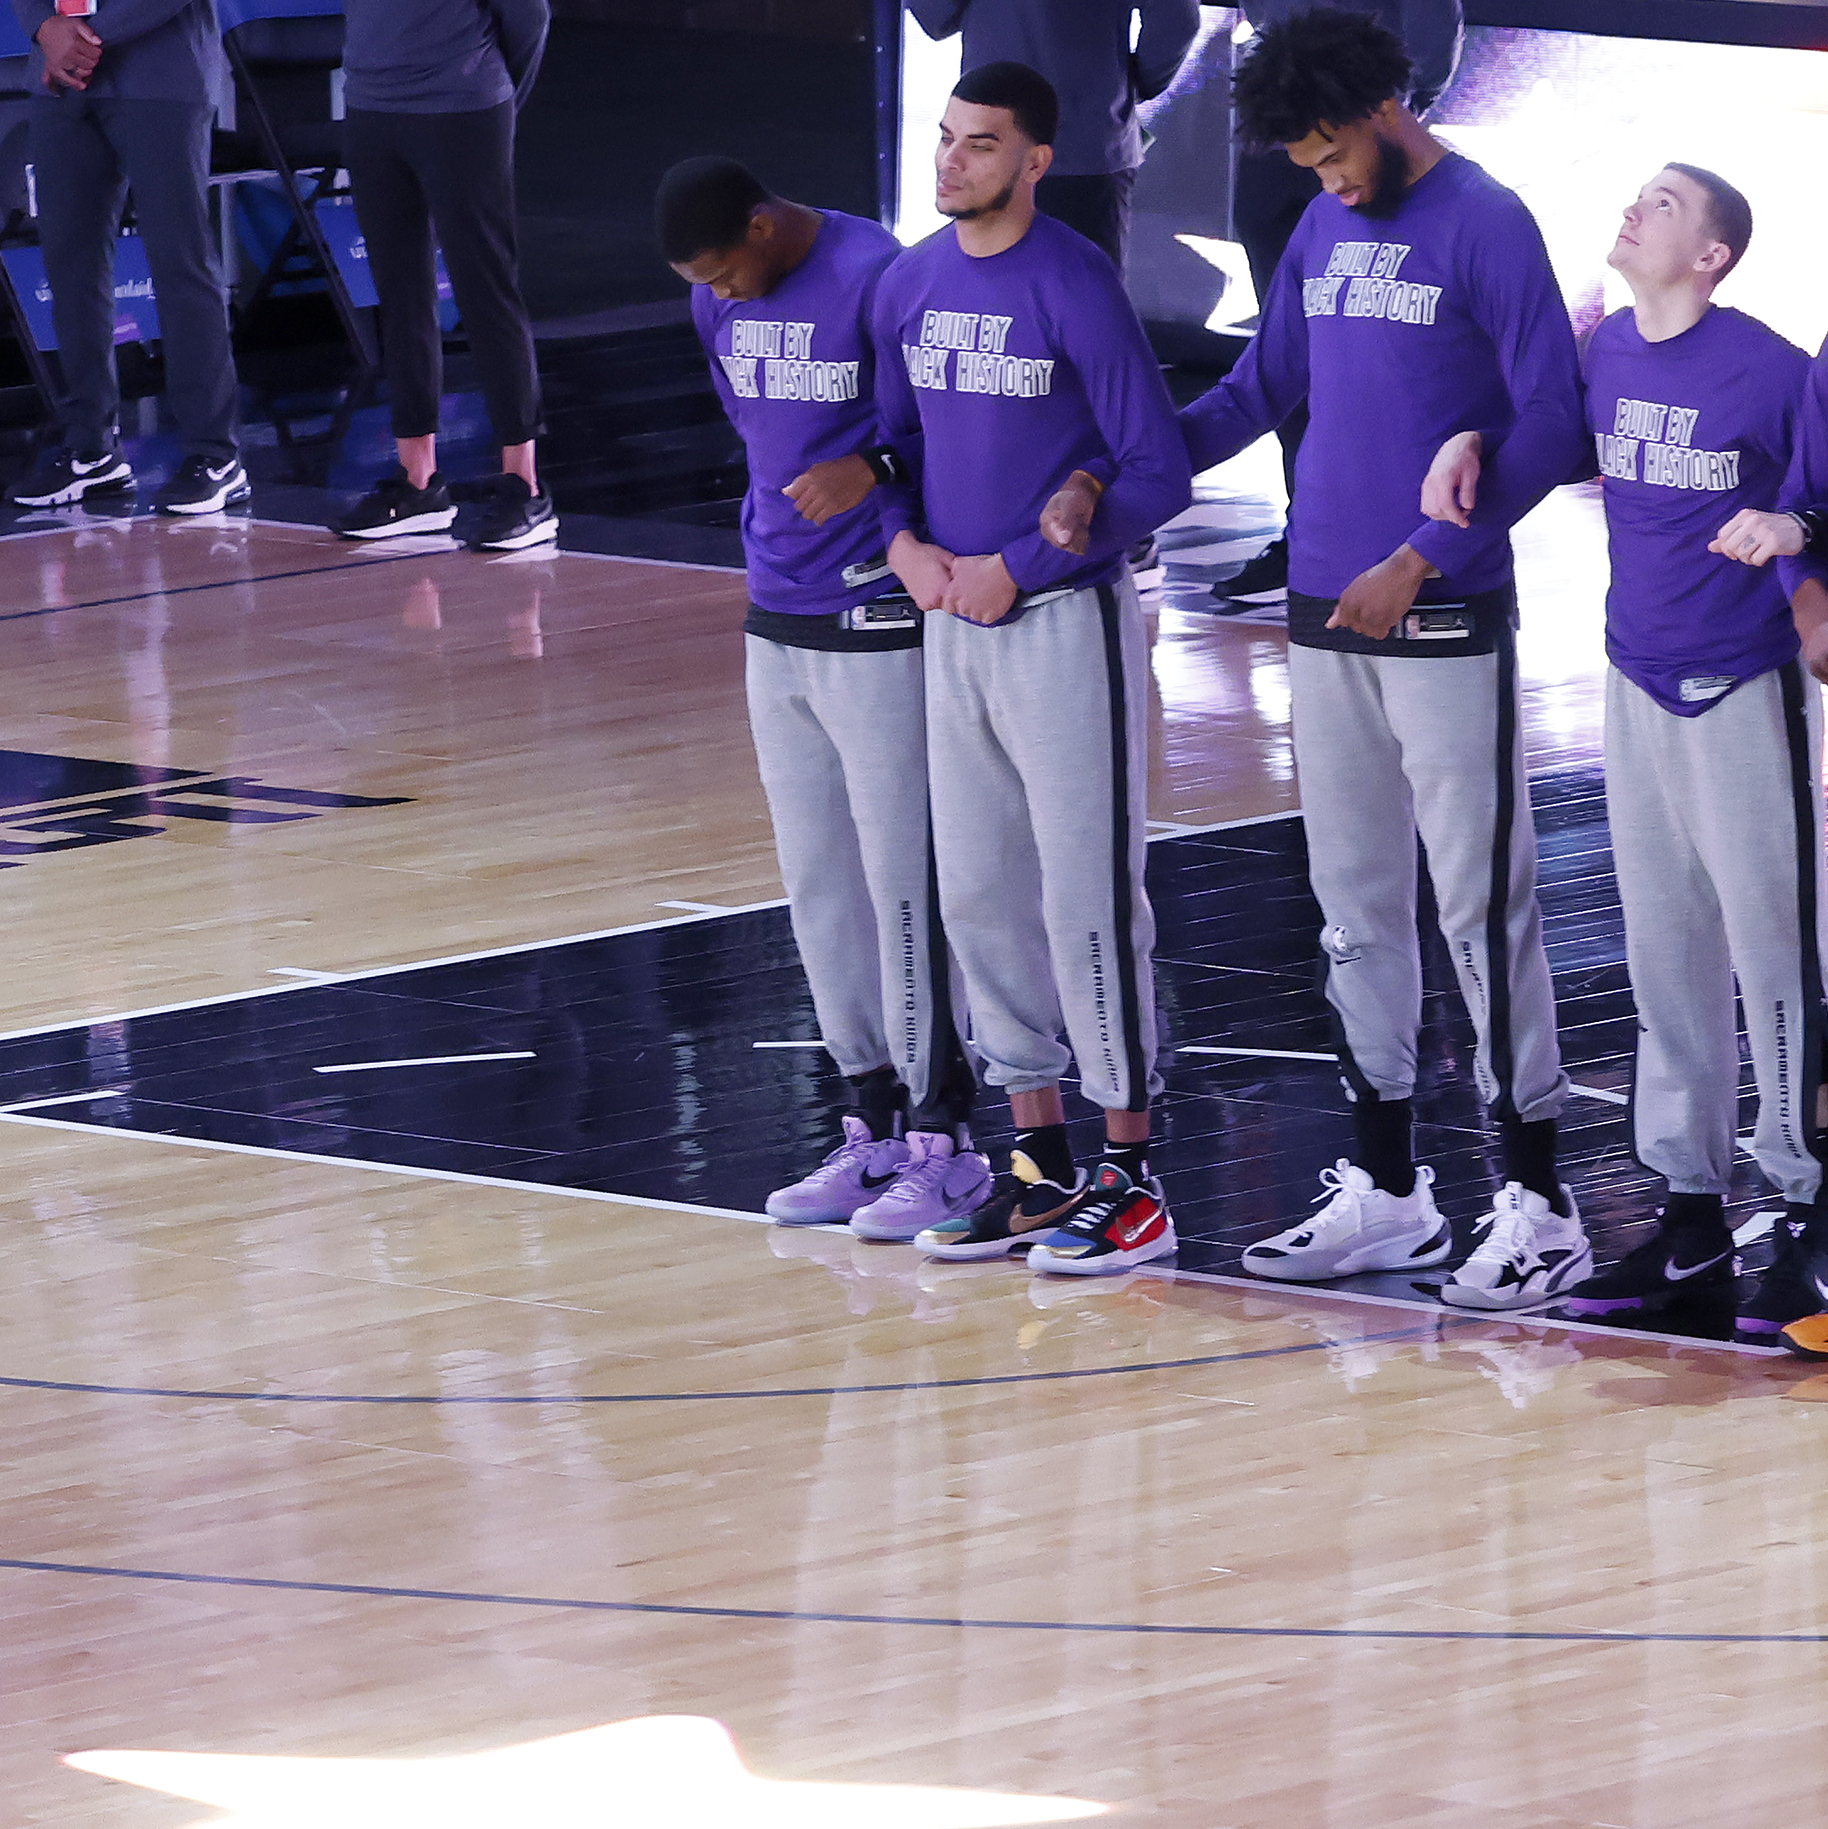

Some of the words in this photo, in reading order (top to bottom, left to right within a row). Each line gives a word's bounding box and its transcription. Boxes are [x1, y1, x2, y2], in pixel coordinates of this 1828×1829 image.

[1326, 241, 1381, 279] BUILT
[1378, 243, 1411, 280] BY
[1342, 279, 1443, 325] HISTORY
[731, 319, 782, 359] BUILT
[784, 321, 815, 360] BY
[920, 309, 975, 350] BUILT
[976, 314, 1013, 354] BY
[720, 355, 759, 400] ACK
[765, 360, 860, 403] HISTORY
[955, 354, 1055, 399] HISTORY
[1615, 398, 1670, 444] BUILT
[1665, 405, 1700, 447] BY
[1596, 431, 1638, 480] LACK
[1641, 440, 1741, 491] HISTORY
